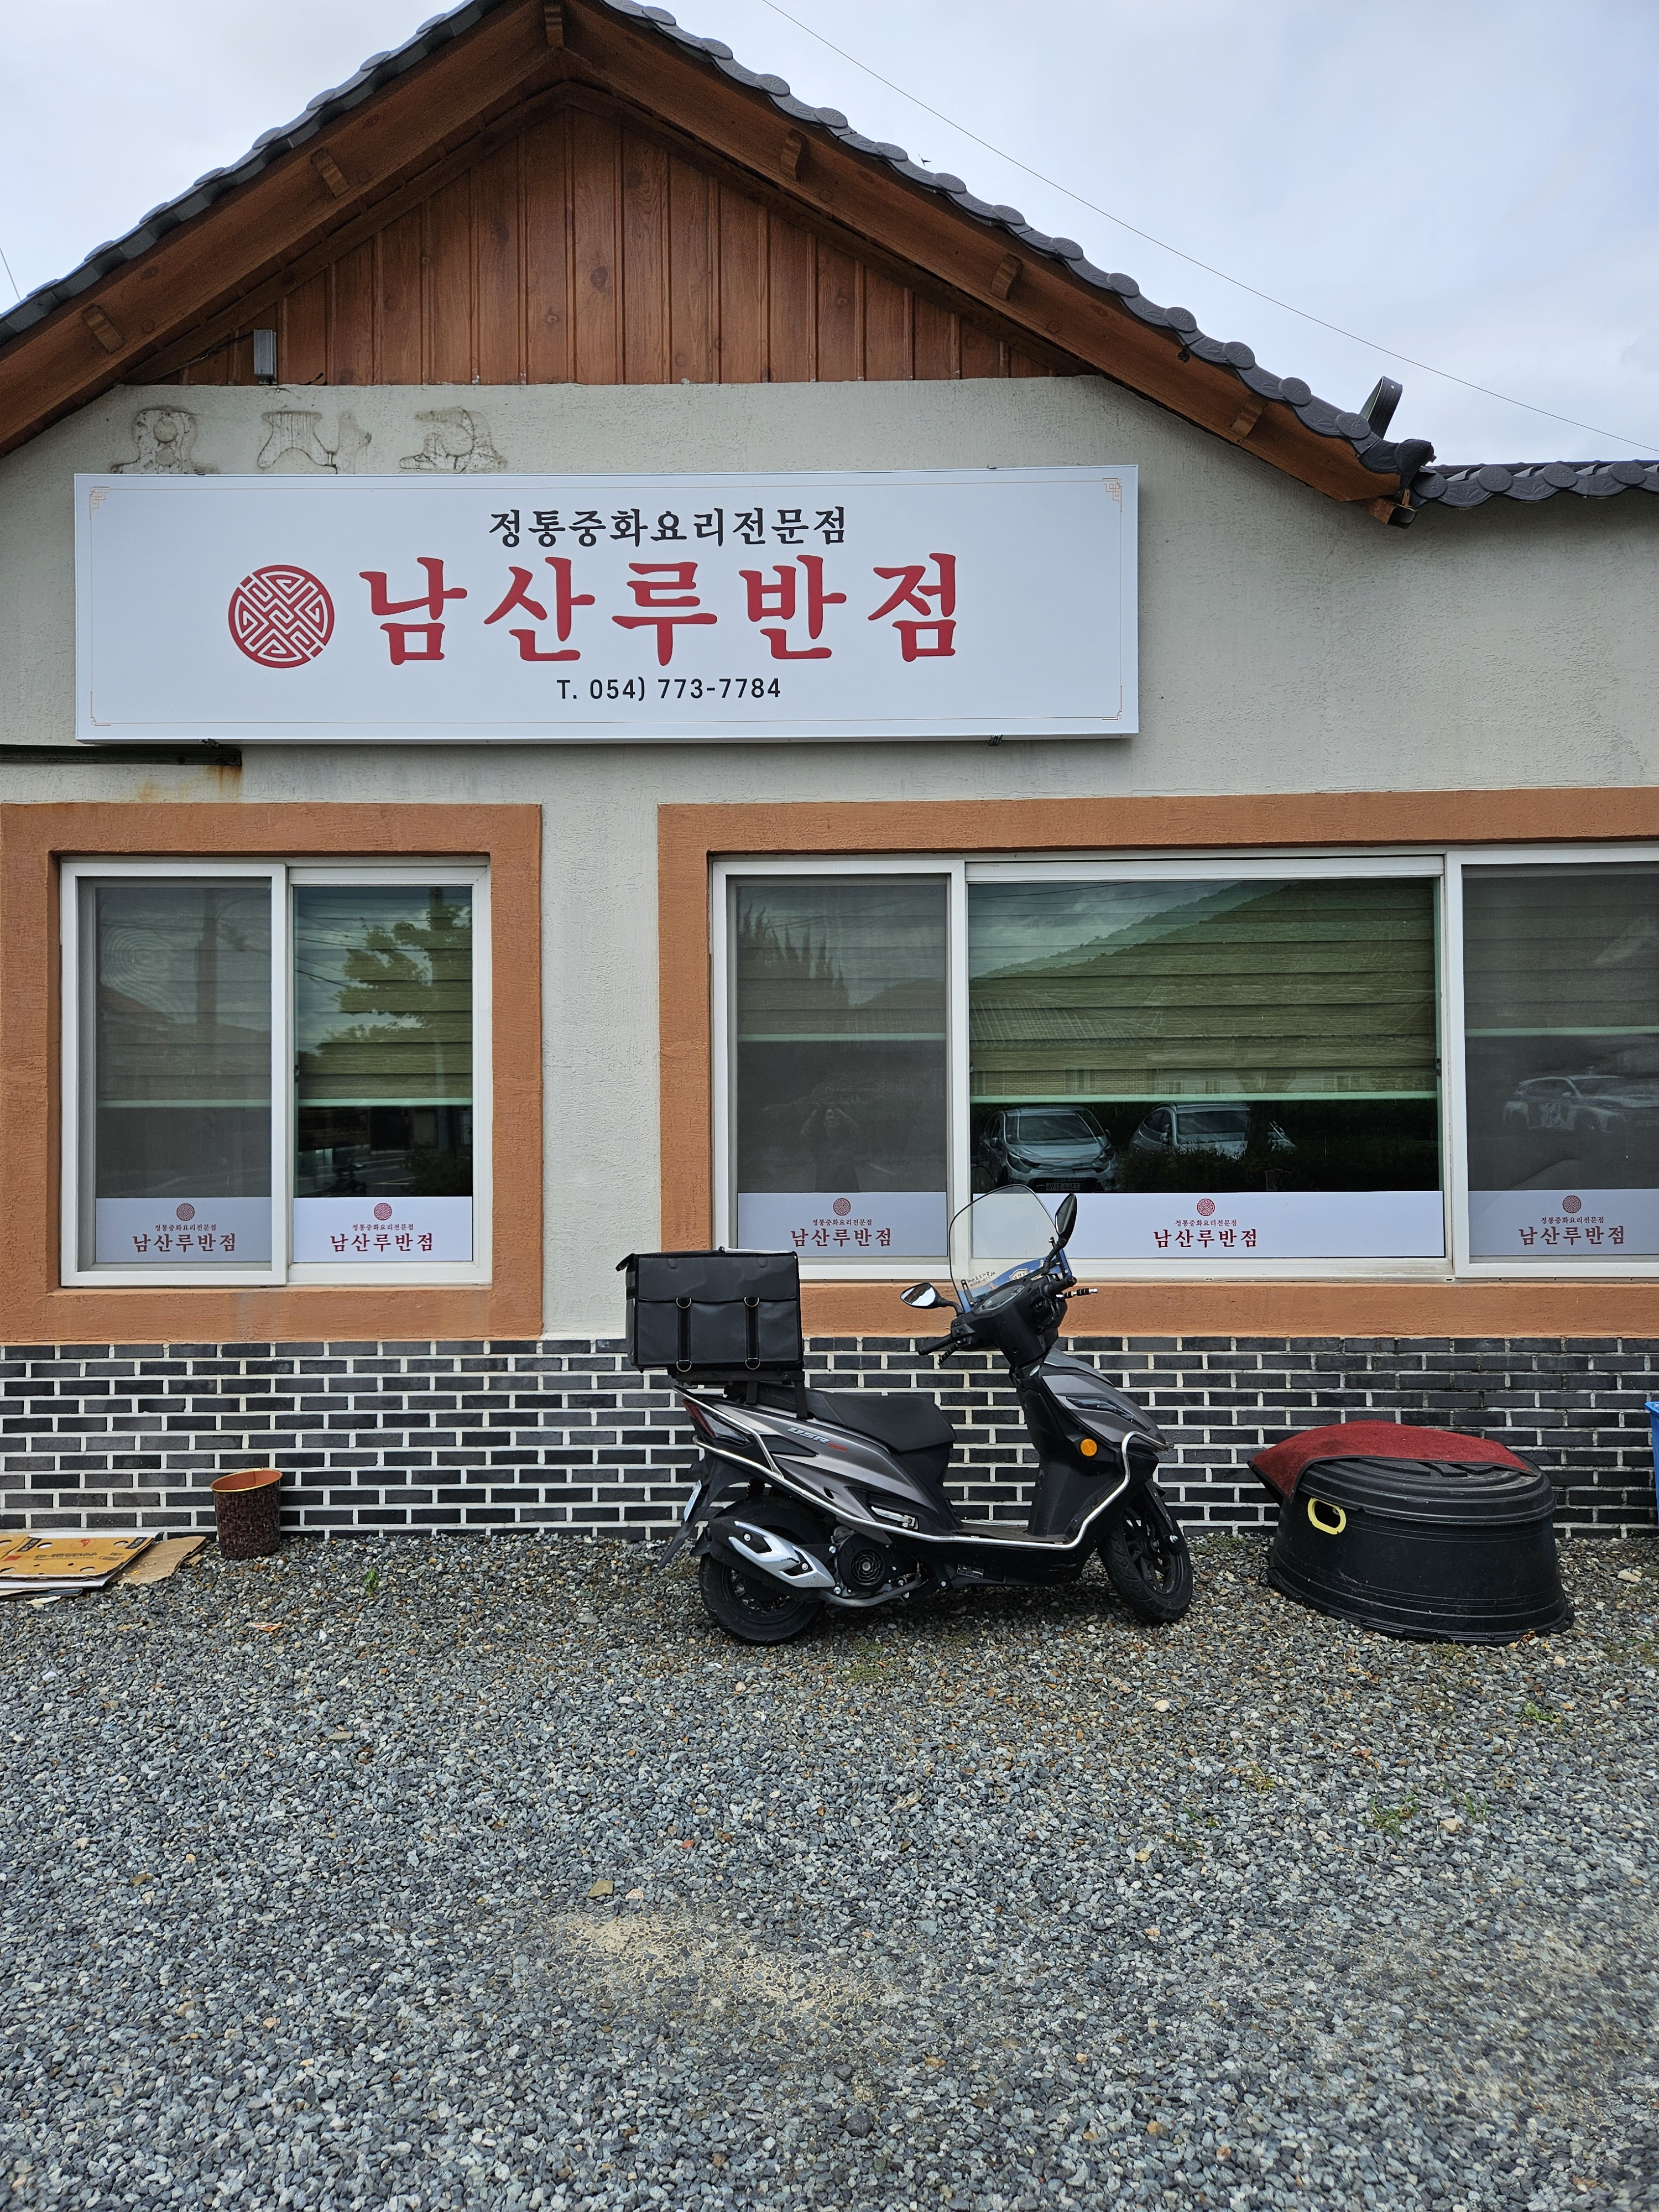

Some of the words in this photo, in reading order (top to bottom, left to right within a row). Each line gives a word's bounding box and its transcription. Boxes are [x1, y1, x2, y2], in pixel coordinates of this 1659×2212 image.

[489, 506, 845, 547] 정통중화요리전문점
[359, 552, 957, 666] 남산루반점
[557, 680, 577, 700] T.
[589, 677, 645, 702] 054)
[658, 678, 781, 699] 773-7784
[1175, 1218, 1237, 1227] 정통중화요리전문점
[132, 1233, 236, 1253] 남산루반점
[330, 1233, 434, 1252] 남산루반점
[790, 1228, 891, 1248] 남산루반점
[1153, 1228, 1257, 1249] 남산루반점
[1518, 1225, 1625, 1246] 남산루반점
[787, 1427, 830, 1444] USR
